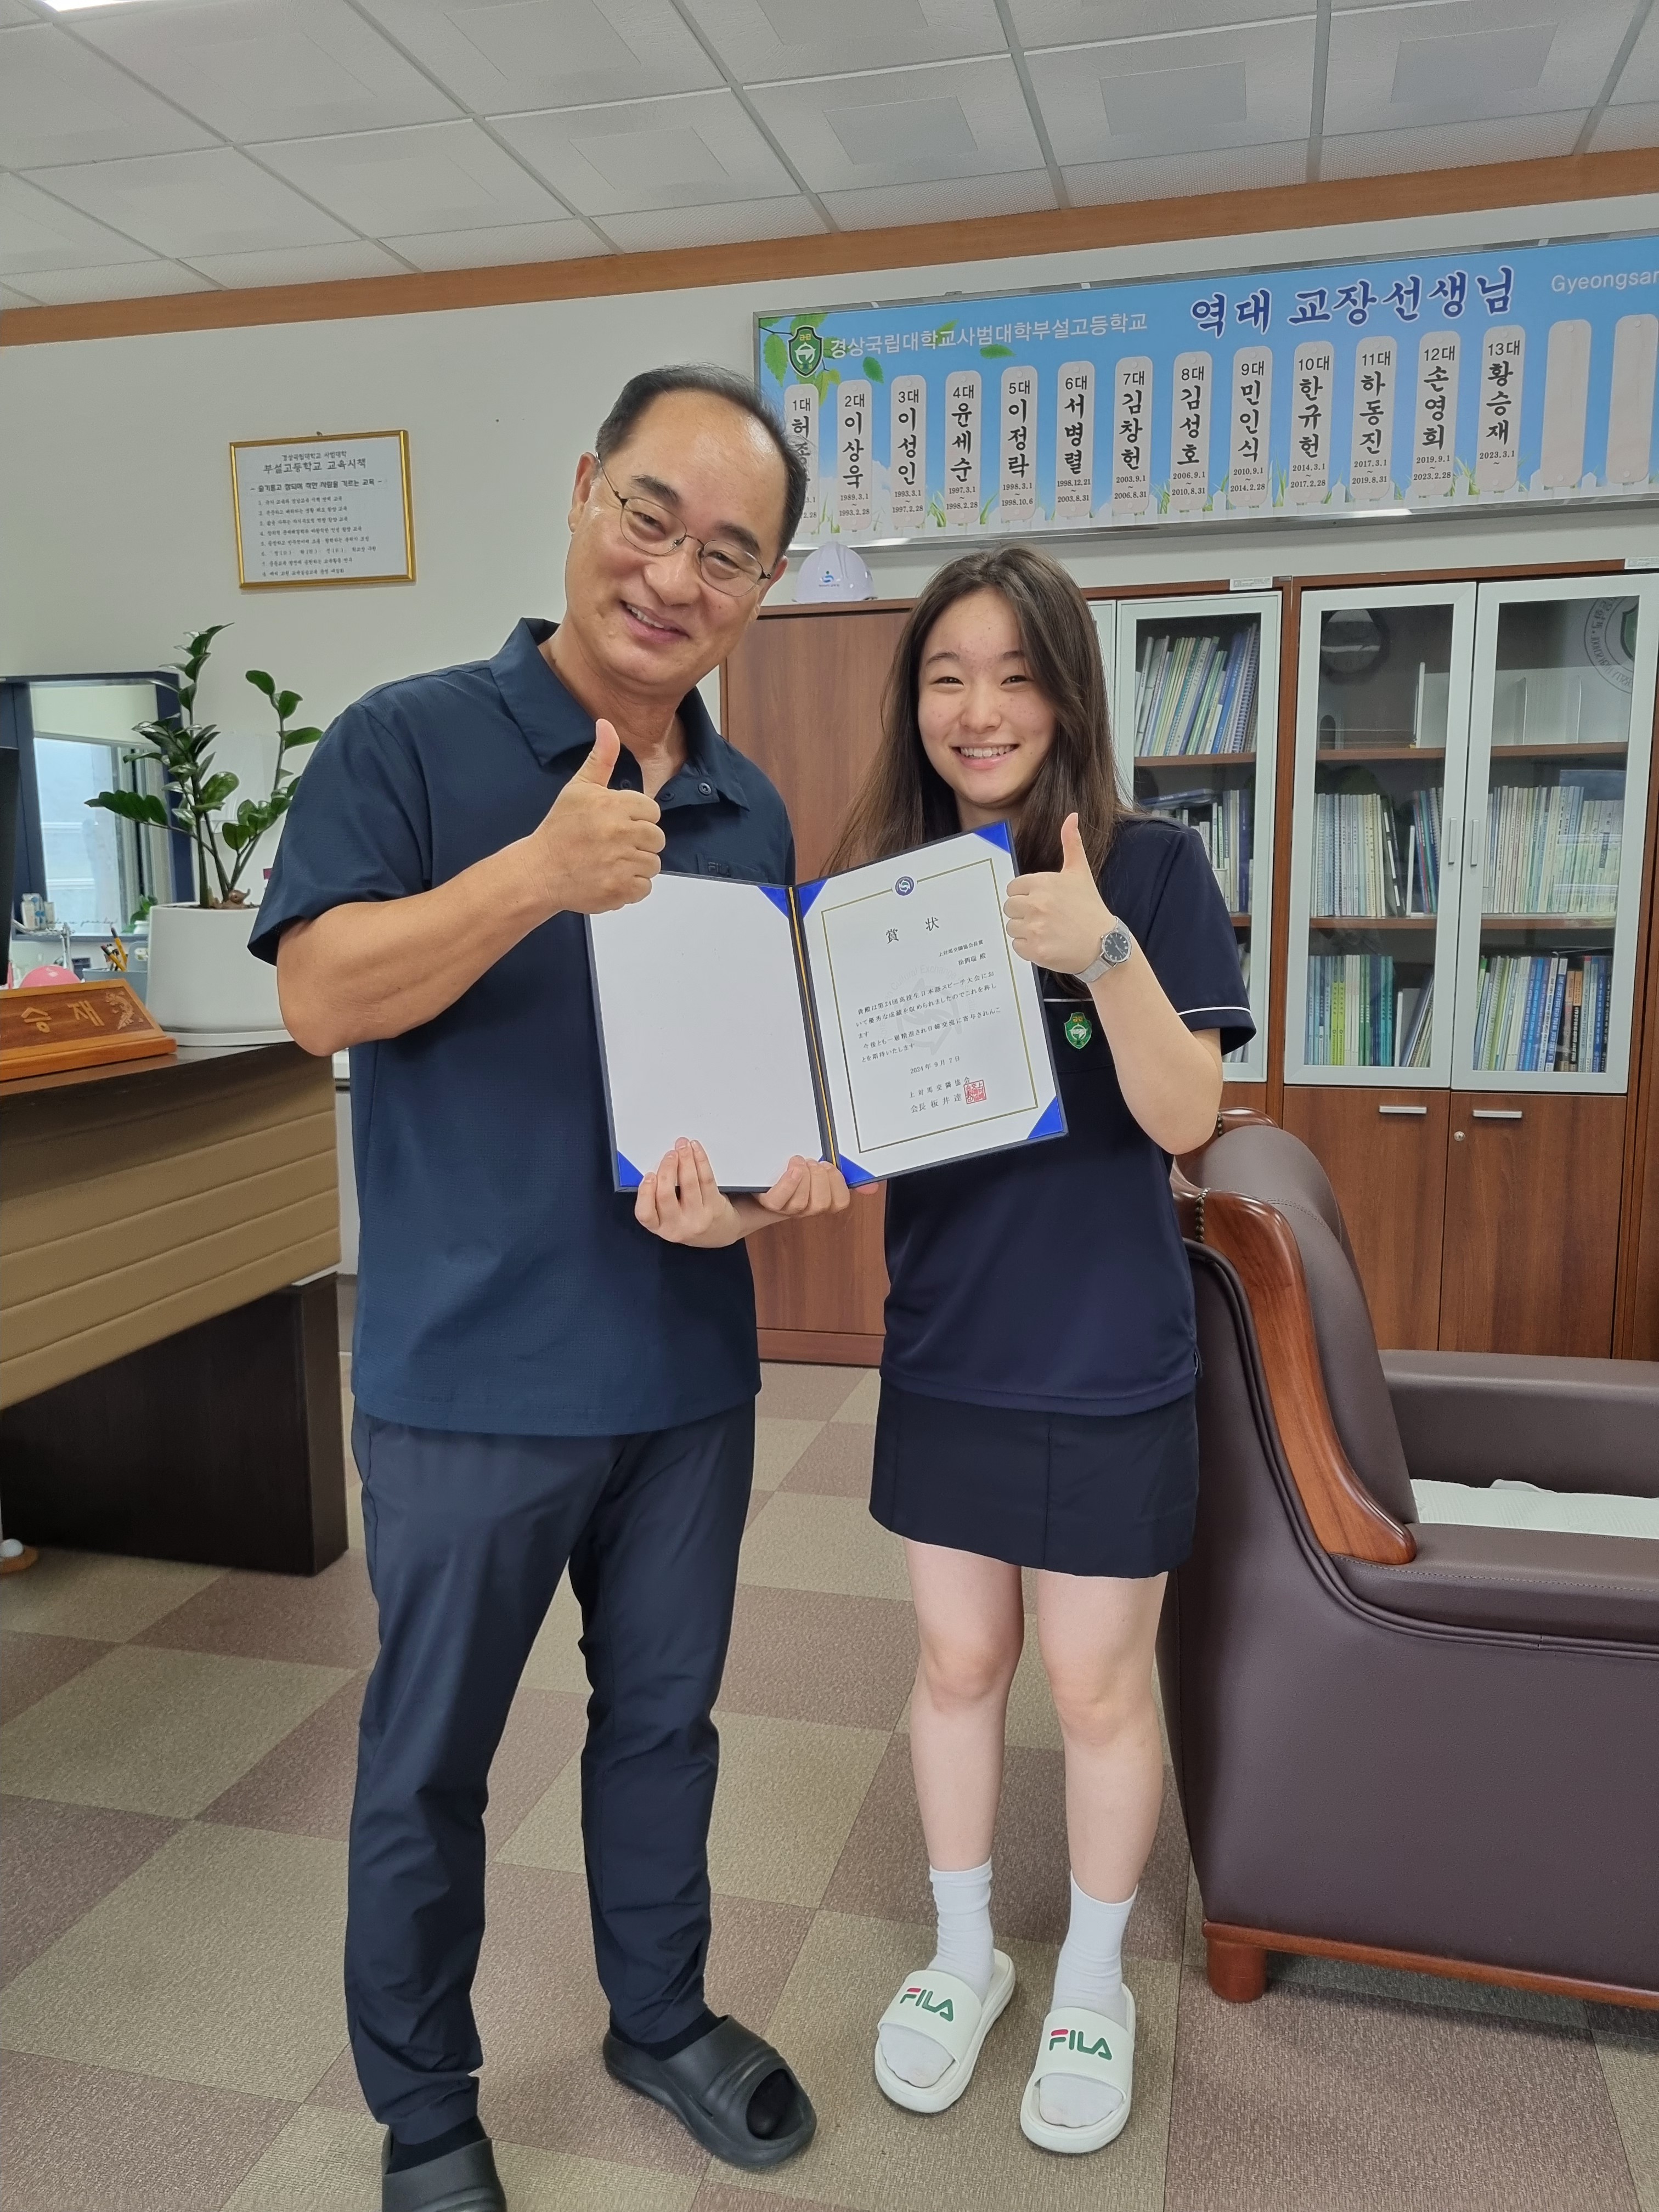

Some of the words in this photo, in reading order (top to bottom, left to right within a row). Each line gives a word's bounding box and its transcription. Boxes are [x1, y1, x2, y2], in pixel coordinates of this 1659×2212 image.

[1191, 291, 1271, 337] 역대
[1288, 267, 1514, 326] 교장선생님
[830, 313, 1148, 359] 경상국립대학교사범대학부설고등학교
[1424, 345, 1455, 362] 12대
[1488, 340, 1520, 357] 13대
[1299, 355, 1330, 371] 10대
[1362, 351, 1391, 366] 11대
[1181, 366, 1204, 381] 8대
[1241, 360, 1264, 376] 9대
[1065, 375, 1087, 390] 6대
[1123, 370, 1145, 385] 7대
[953, 385, 974, 399] 4대
[1009, 380, 1030, 394] 5대
[845, 393, 865, 408] 2대
[898, 388, 919, 403] 3대
[1486, 360, 1514, 445] 황승재
[793, 398, 811, 411] 1대
[1298, 375, 1323, 459] 한규헌
[1359, 371, 1386, 455] 하동진
[1177, 385, 1200, 465] 김성호
[1238, 380, 1261, 462] 민인식
[1064, 393, 1084, 475] 서병렬
[1119, 390, 1143, 470] 김창헌
[950, 403, 973, 482] 윤세순
[1008, 398, 1030, 478] 이정락
[842, 411, 865, 489] 이상욱
[898, 407, 917, 486] 이성인
[1416, 455, 1450, 464] 2019.9.1
[1480, 450, 1515, 459] 2023.3.1
[263, 461, 322, 474] 부설고등학교
[328, 458, 366, 470] 교육시책
[1293, 463, 1325, 472] 2014.3.1
[1354, 459, 1387, 467] 2017.3.1
[1116, 475, 1146, 483] 2003.9.1
[1173, 471, 1205, 479] 2006.9.1
[1234, 467, 1263, 476] 2010.9.1
[1413, 472, 1451, 481] 2023.2.28
[341, 479, 359, 487] 기르는
[362, 478, 375, 486] 교육
[1057, 478, 1091, 487] 1998.12.21
[1231, 483, 1265, 492] 2014.2.28
[1290, 479, 1326, 488] 2017.2.28
[1352, 476, 1387, 485] 2019.8.31
[949, 486, 976, 494] 1997.3.1
[946, 502, 978, 510] 1998.2.28
[1002, 498, 1033, 506] 1998.10.6
[708, 862, 731, 877] FILA
[885, 917, 939, 944] 賞状
[862, 1043, 915, 1063] とを期待いたします
[899, 1987, 955, 2022] FILA
[1048, 2029, 1113, 2061] FILA
